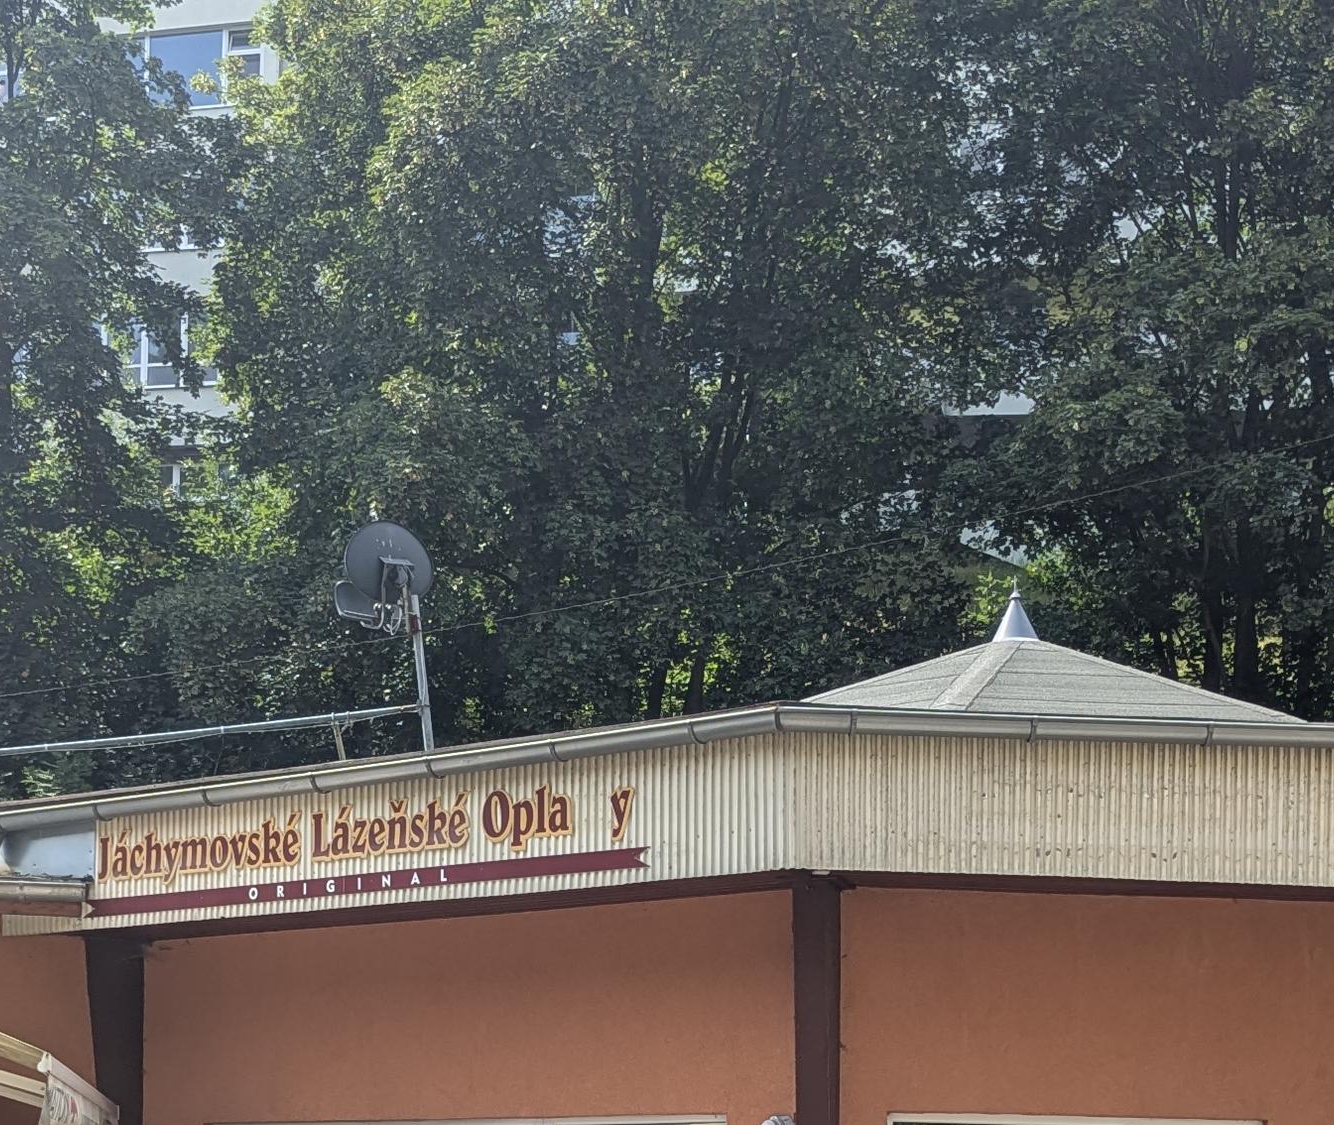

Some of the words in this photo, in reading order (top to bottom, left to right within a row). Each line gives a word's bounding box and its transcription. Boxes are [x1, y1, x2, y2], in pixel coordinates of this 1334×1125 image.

[98, 810, 301, 885] Jáchymovské
[311, 789, 470, 863] Lázeňské
[248, 868, 450, 901] ORIGINAL
